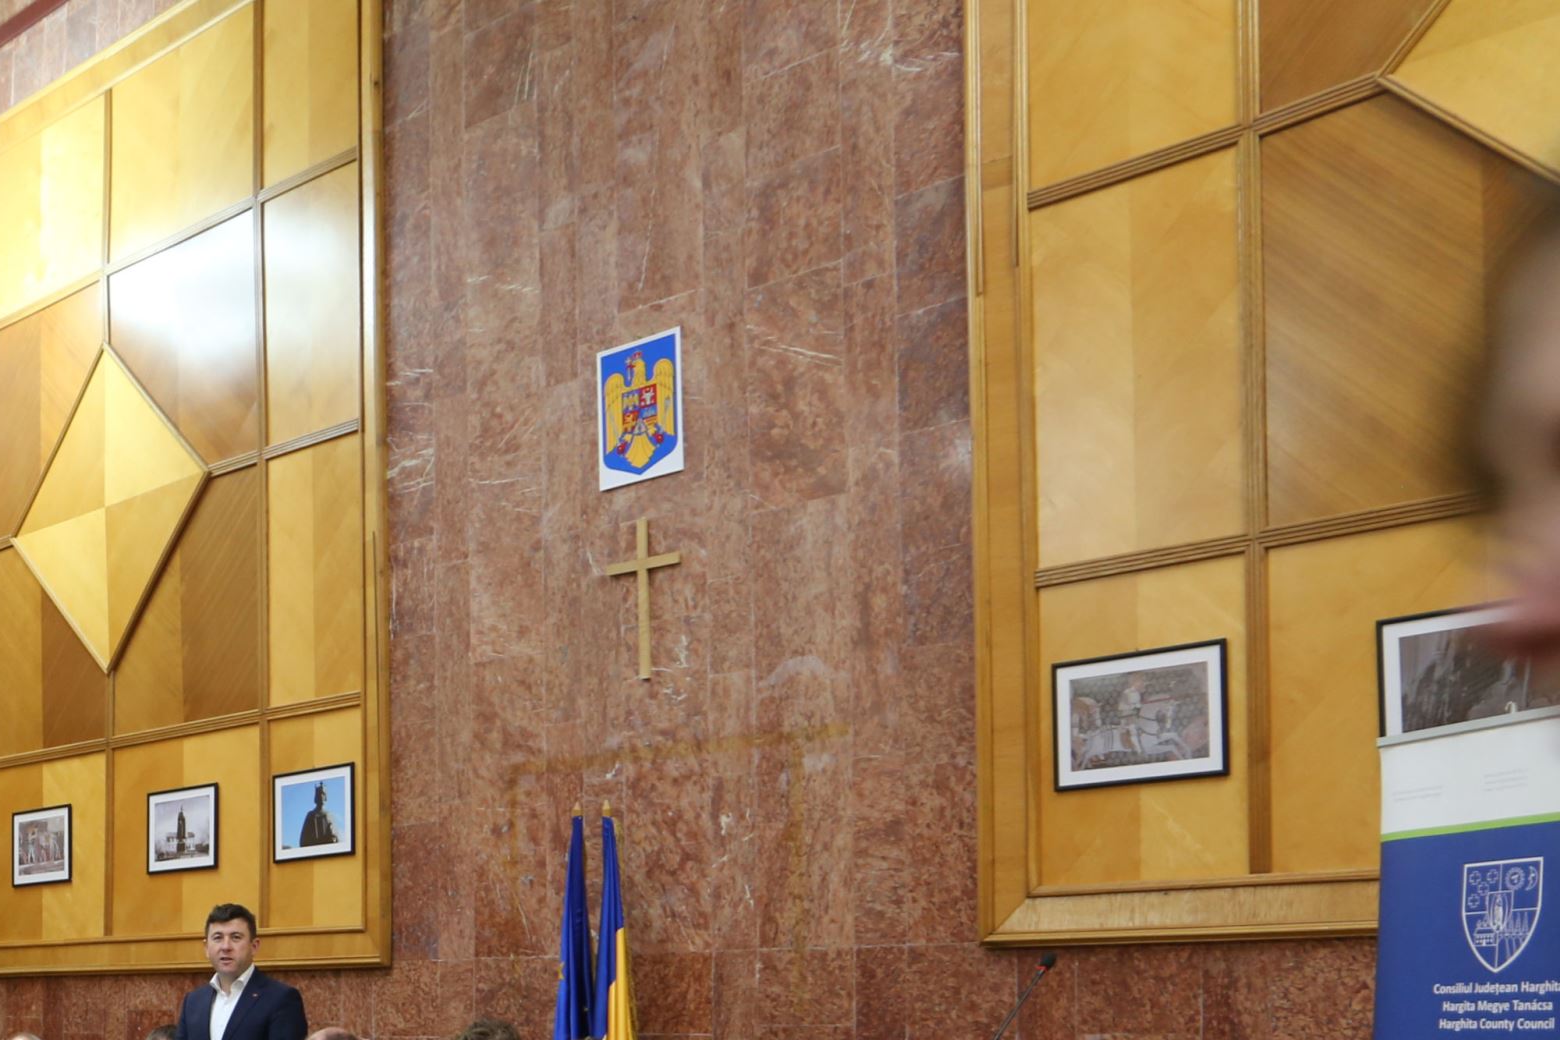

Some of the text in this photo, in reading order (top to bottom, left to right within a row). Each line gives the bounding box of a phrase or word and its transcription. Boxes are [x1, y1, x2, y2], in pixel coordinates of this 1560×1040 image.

[1433, 982, 1473, 994] Consiliul
[1442, 999, 1553, 1014] Hargita Megye Tanácsa
[1439, 1017, 1555, 1031] Harghita County Council
